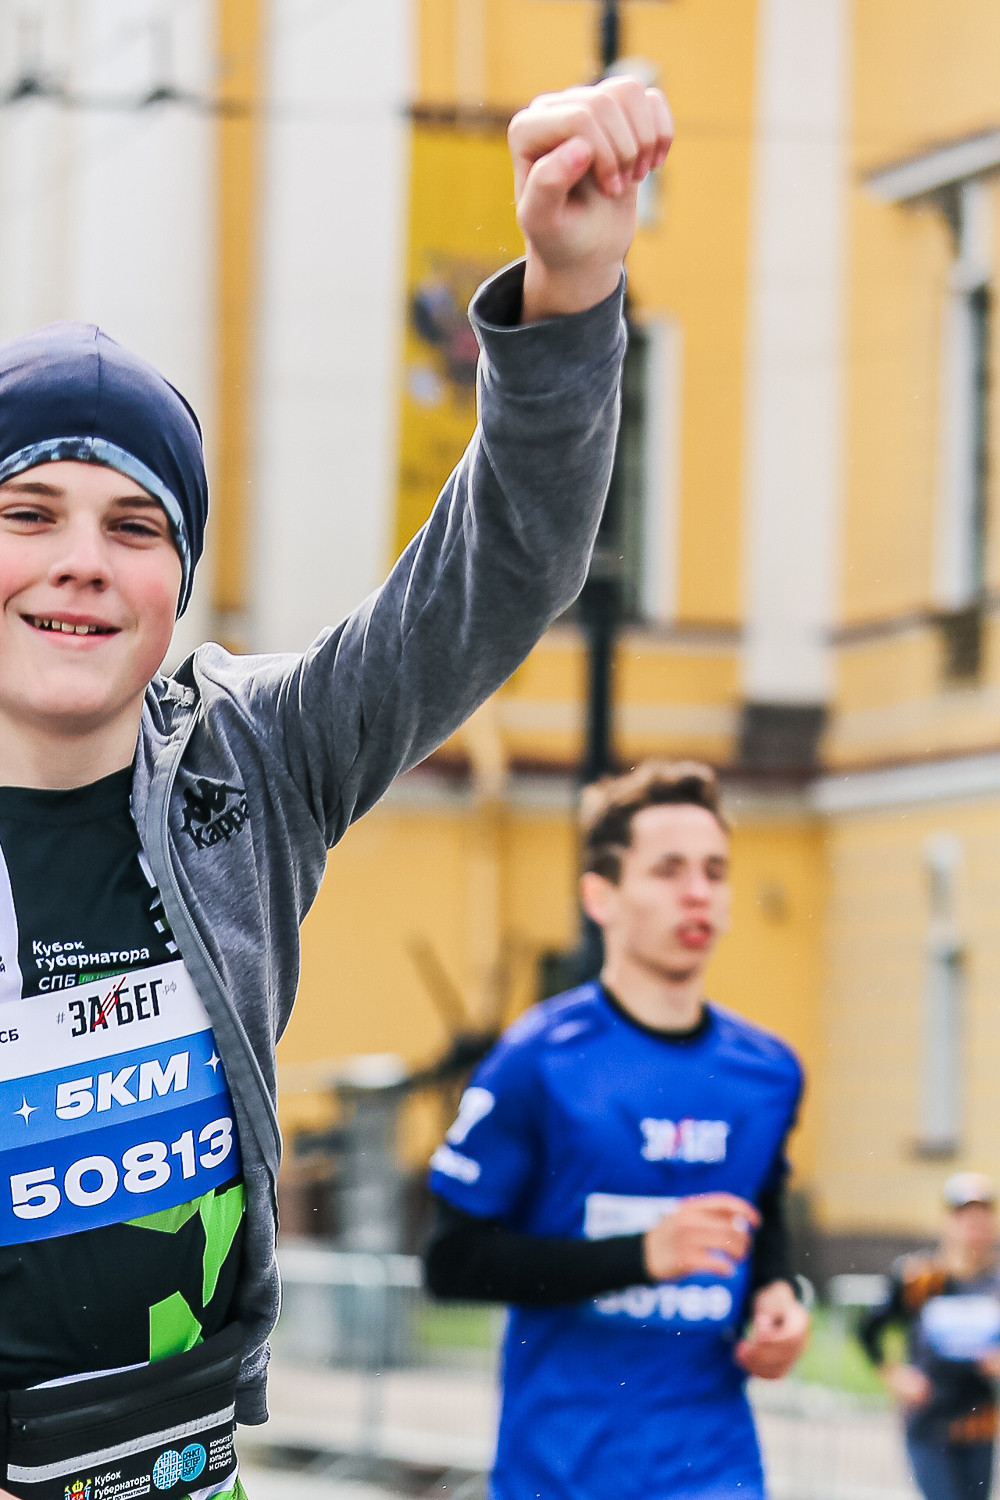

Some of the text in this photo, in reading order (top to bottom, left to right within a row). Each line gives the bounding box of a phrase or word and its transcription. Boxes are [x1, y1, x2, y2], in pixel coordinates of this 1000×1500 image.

[32, 940, 85, 956] Кубок
[35, 947, 150, 972] губернатора
[38, 974, 77, 991] СПБ
[10, 1117, 233, 1220] 50813
[94, 1470, 121, 1486] Кубок
[94, 1474, 151, 1500] Губернатора
